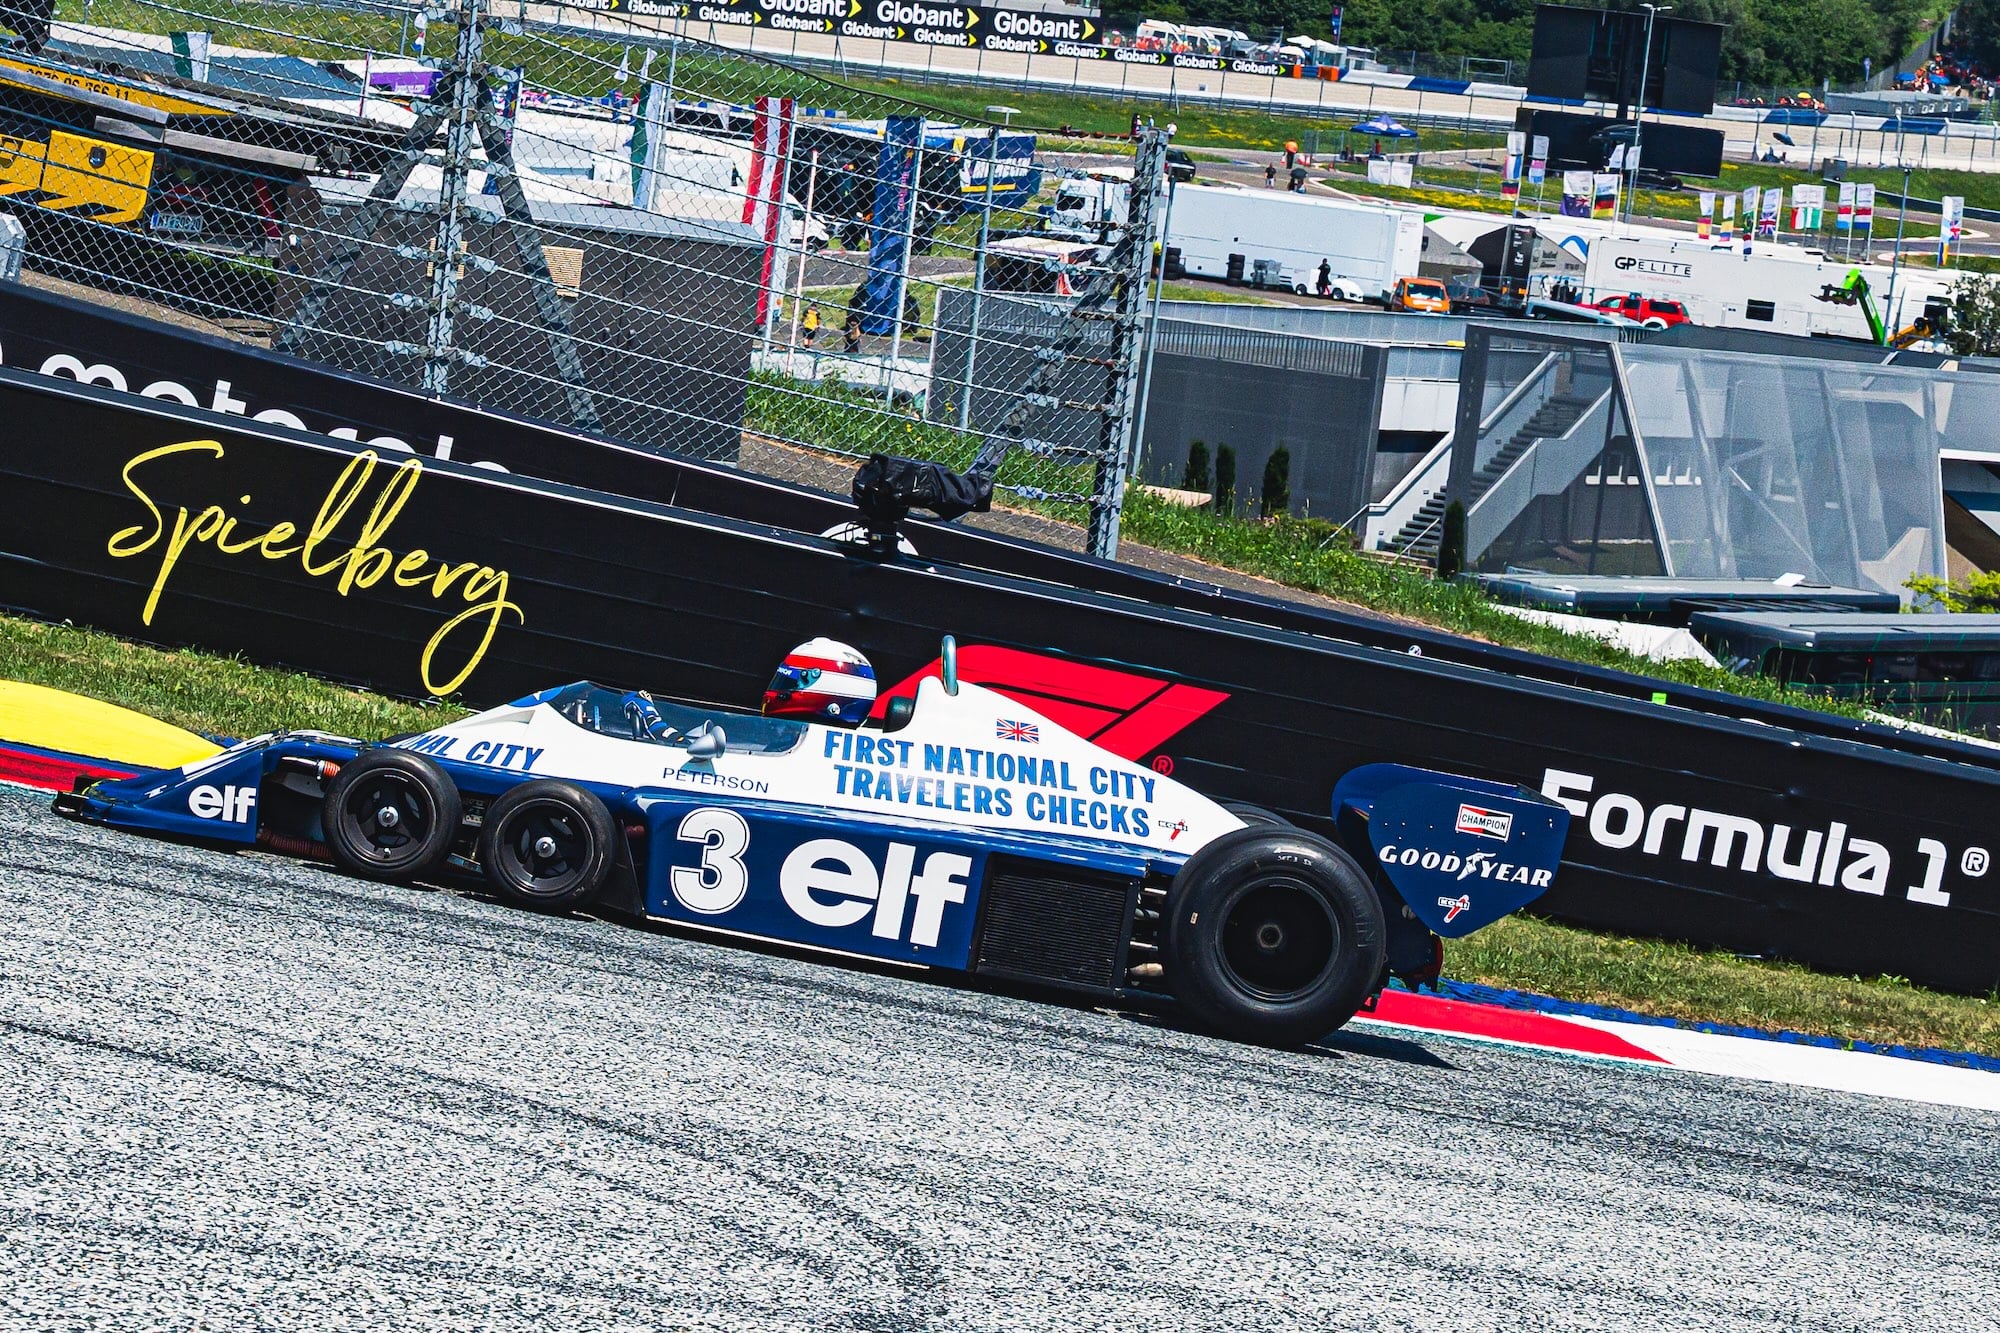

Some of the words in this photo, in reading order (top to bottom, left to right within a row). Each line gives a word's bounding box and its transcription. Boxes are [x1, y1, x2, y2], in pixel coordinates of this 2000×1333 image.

[699, 6, 752, 25] Globant
[771, 13, 825, 33] Globant
[877, 0, 964, 28] Globant
[842, 20, 896, 39] Globant
[994, 11, 1080, 40] Globant
[914, 28, 967, 46] Globant
[985, 34, 1038, 52] Globant
[1055, 43, 1100, 60] Globant
[1114, 49, 1160, 66] Globant
[1173, 55, 1219, 70] Globant
[1232, 60, 1279, 75] Globant
[1614, 256, 1637, 271] GP
[1638, 261, 1692, 276] ELITE
[108, 440, 525, 697] Spielberg
[466, 742, 544, 771] CITY
[823, 730, 914, 769] FIRST
[923, 743, 1078, 792] NATIONAL
[1089, 766, 1156, 804] CITY
[662, 766, 770, 794] PETERSON
[188, 784, 257, 824] elf
[833, 764, 1014, 817] TRAVELERS
[1025, 792, 1151, 838] CHECKS
[1460, 813, 1507, 831] CHAMPION
[1540, 767, 1891, 896] Formula
[1906, 837, 1951, 907] 1
[670, 806, 751, 915] 3
[779, 838, 973, 948] elf
[1439, 897, 1469, 909] KONI
